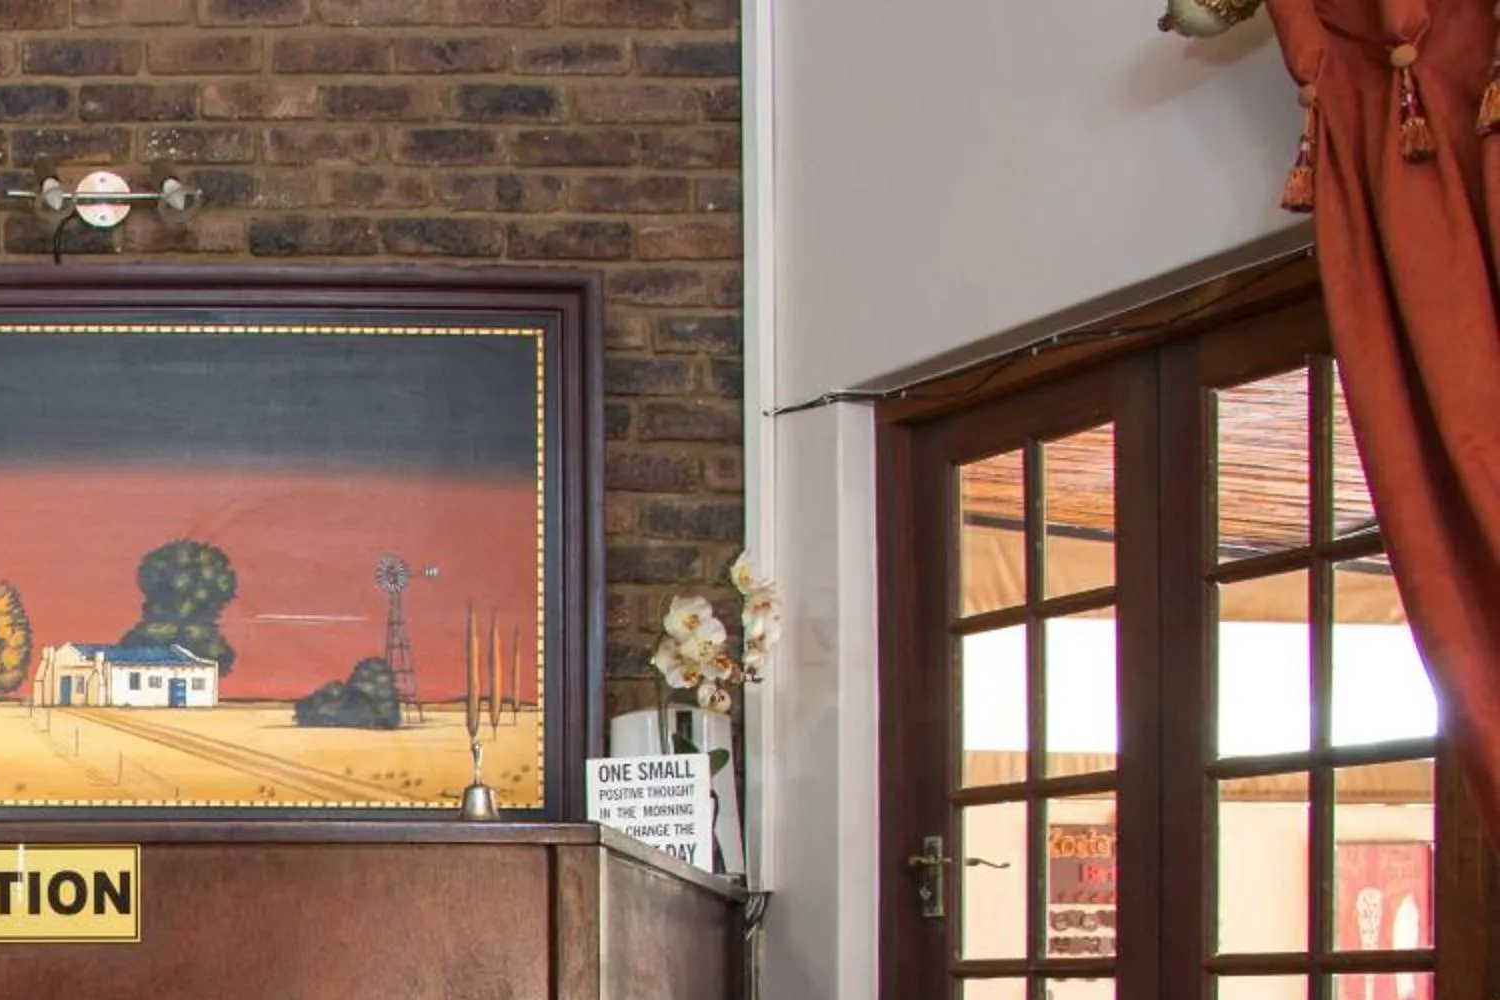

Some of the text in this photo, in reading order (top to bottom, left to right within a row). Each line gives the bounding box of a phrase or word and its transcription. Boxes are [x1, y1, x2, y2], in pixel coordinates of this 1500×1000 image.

[598, 759, 695, 783] ONE SMALL
[599, 784, 695, 800] POSITIVE THOUGHT
[600, 803, 695, 819] IN THE MORNING
[625, 822, 695, 838] CHANGE THE
